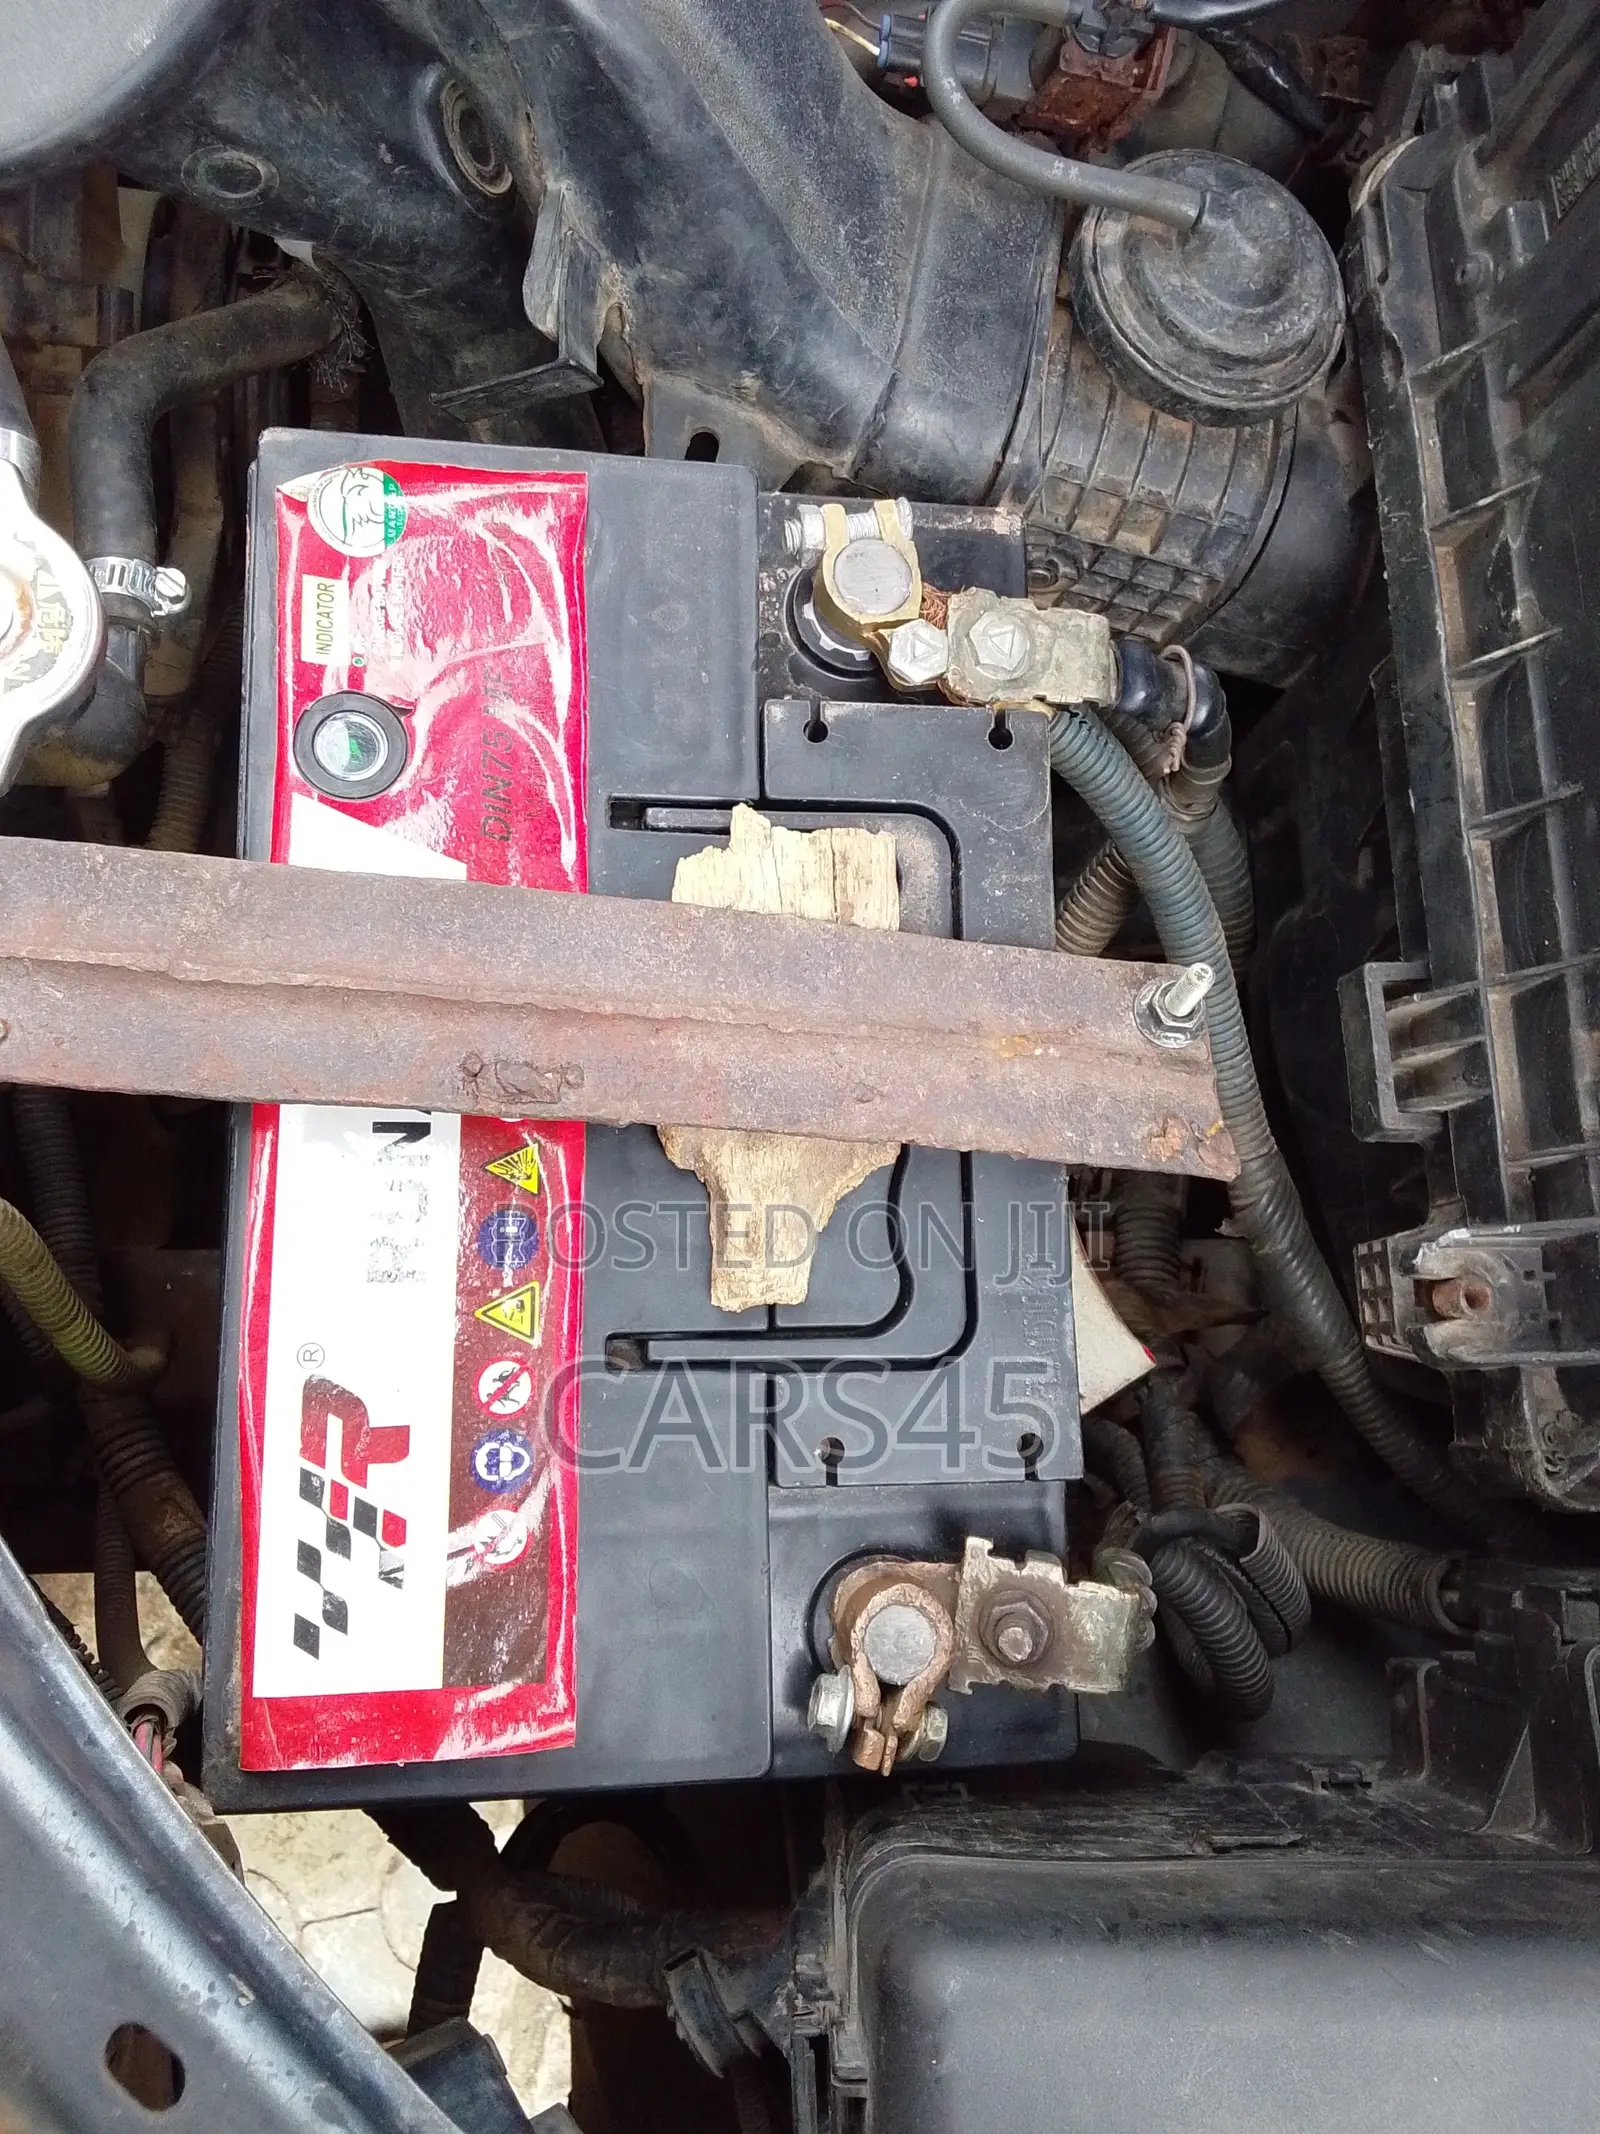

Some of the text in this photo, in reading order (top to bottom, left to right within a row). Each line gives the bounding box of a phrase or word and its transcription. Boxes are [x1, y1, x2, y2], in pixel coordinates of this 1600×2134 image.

[315, 581, 336, 656] INDICATOR
[480, 727, 514, 842] DIN75
[366, 1109, 432, 1283] RUN
